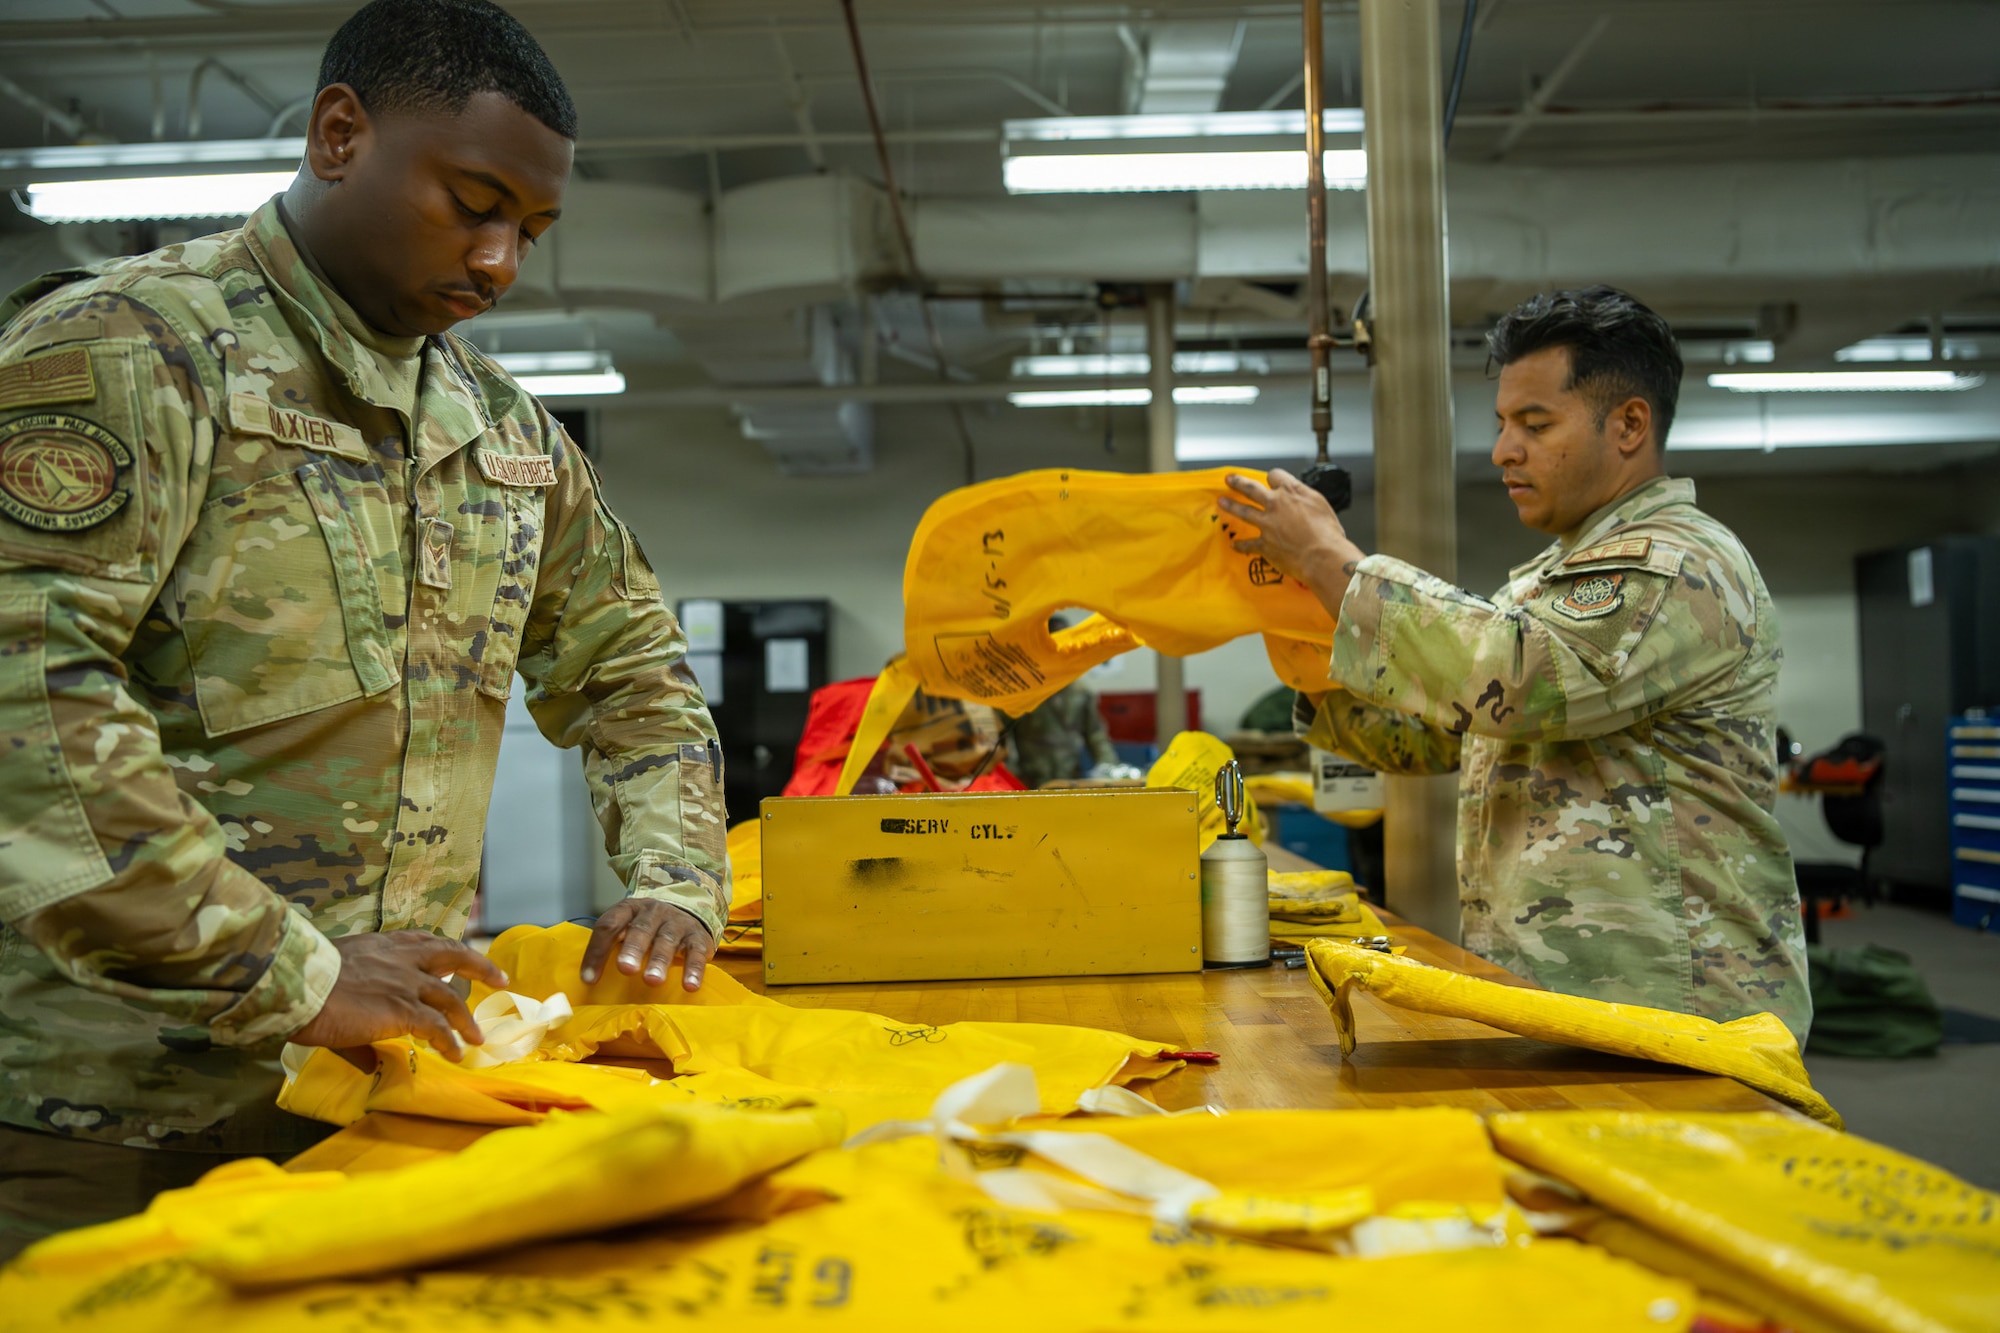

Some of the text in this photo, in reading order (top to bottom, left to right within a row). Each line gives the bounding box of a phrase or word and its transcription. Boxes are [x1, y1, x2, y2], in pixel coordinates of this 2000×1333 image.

[519, 459, 554, 483] FORCE
[64, 503, 113, 528] SUPPORT
[1578, 540, 1645, 560] AFE
[971, 824, 1013, 840] CYL.
